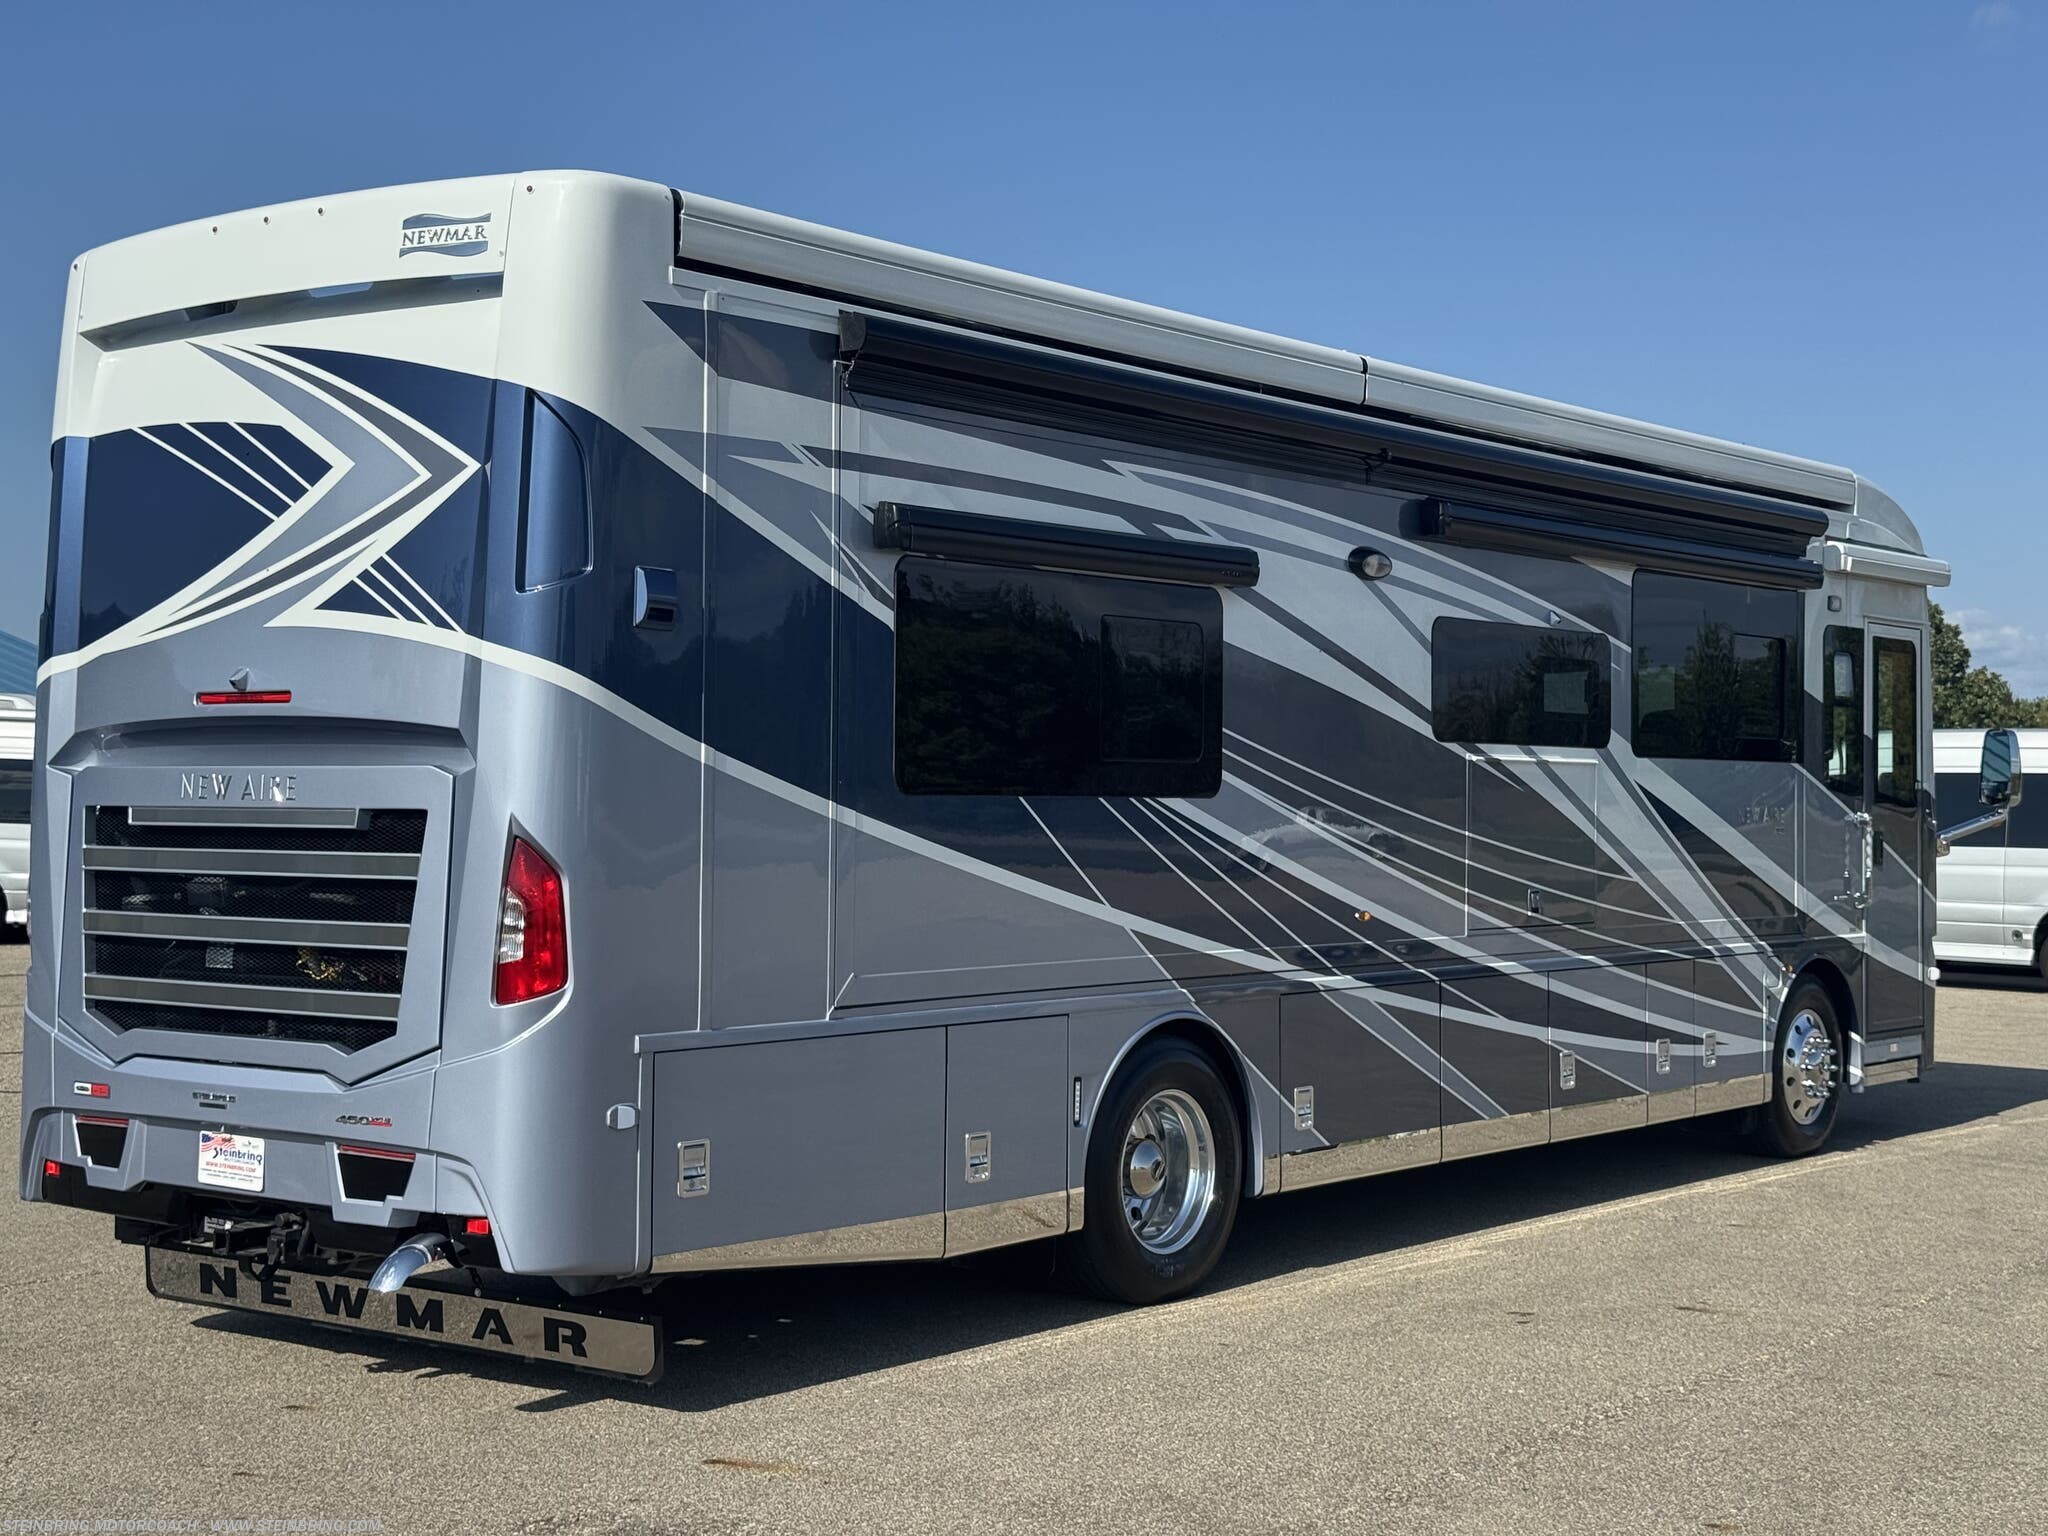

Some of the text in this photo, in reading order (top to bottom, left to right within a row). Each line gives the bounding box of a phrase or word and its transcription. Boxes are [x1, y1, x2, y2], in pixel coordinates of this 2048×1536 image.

[402, 224, 488, 247] NEWMAR
[180, 772, 297, 802] NEW AIRE
[212, 1146, 263, 1166] Steinbring
[199, 1263, 588, 1358] NEWMAR
